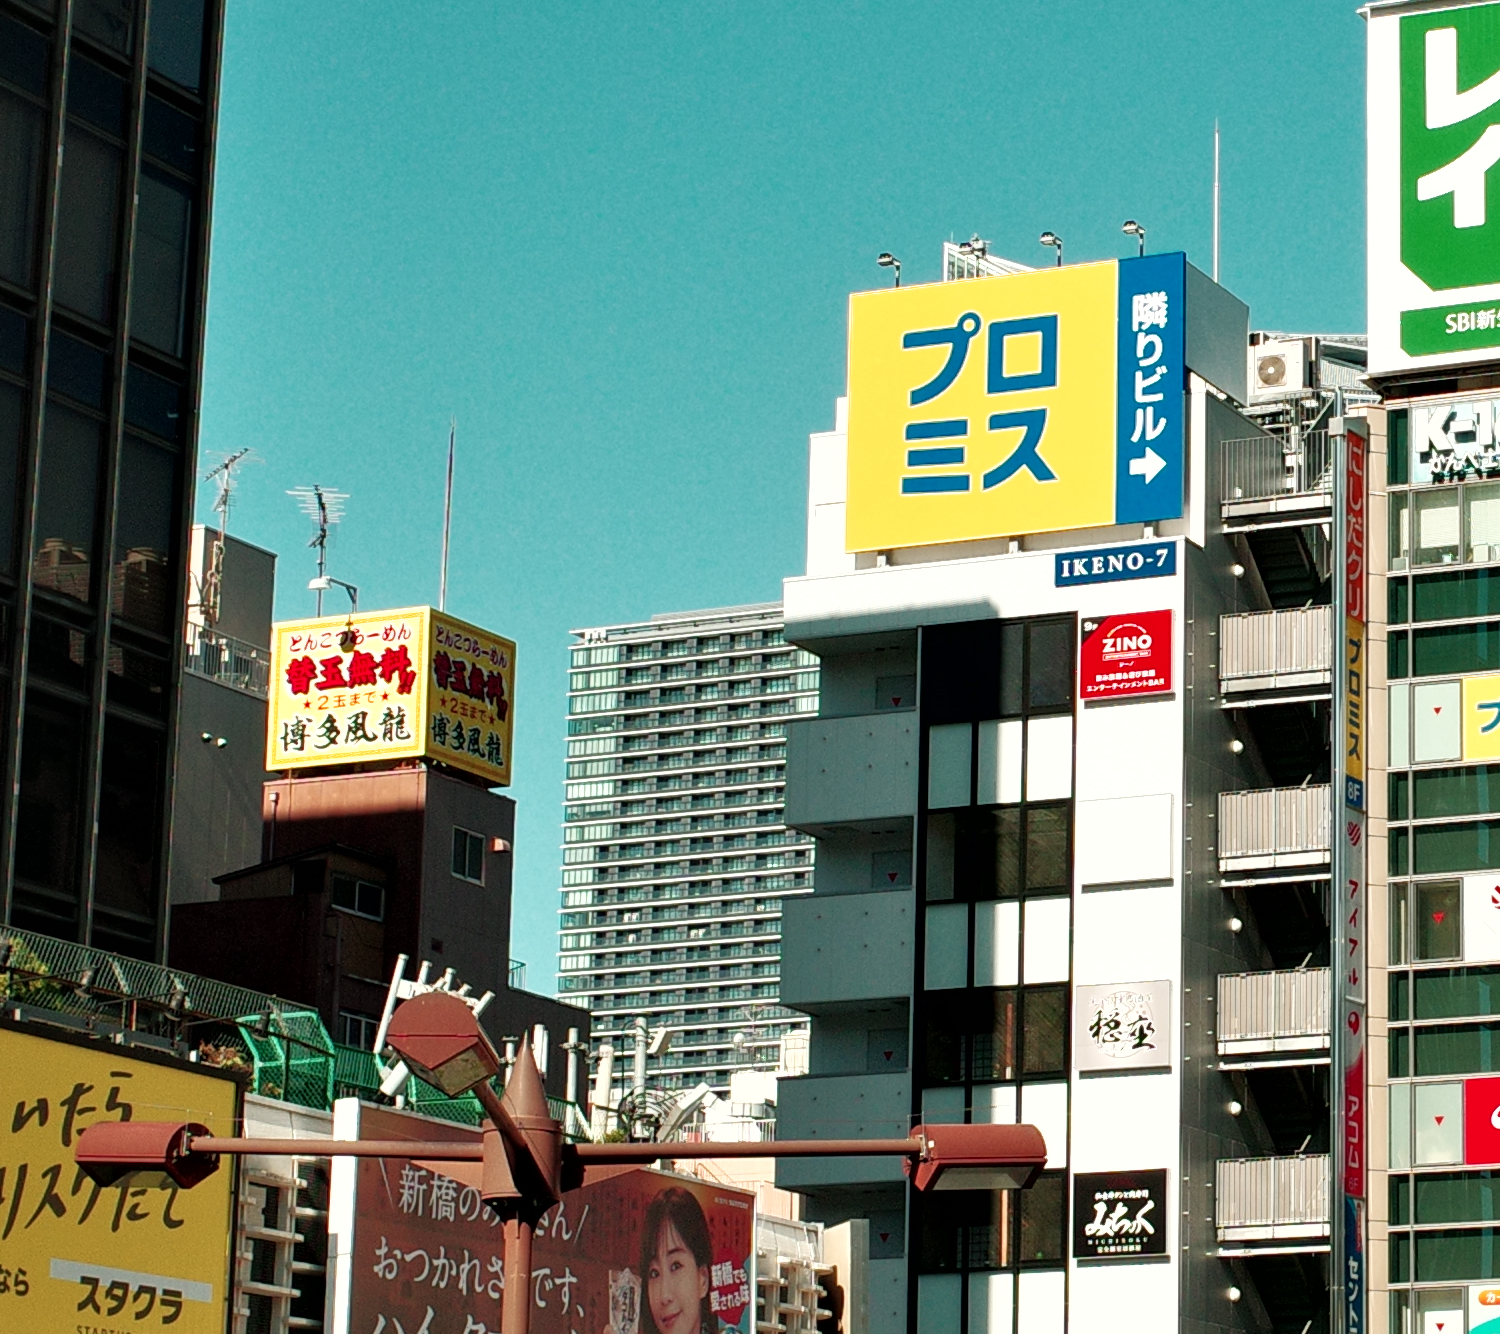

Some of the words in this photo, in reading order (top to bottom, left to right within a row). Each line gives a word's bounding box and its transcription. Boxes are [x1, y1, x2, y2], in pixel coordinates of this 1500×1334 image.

[1130, 291, 1168, 443] 隣りビル
[1347, 434, 1363, 616] にしだクリ
[1060, 547, 1169, 579] IKENO-7
[1102, 634, 1152, 653] ZINO
[280, 706, 411, 752] 博多風龍
[1349, 638, 1360, 758] プロミス
[430, 715, 504, 767] 博多風龍
[1347, 781, 1360, 802] 8F
[1348, 880, 1358, 986] アイフル
[1347, 1094, 1359, 1169] アコム
[77, 1275, 182, 1325] スタクラ
[373, 1236, 585, 1318] おつかれさです、
